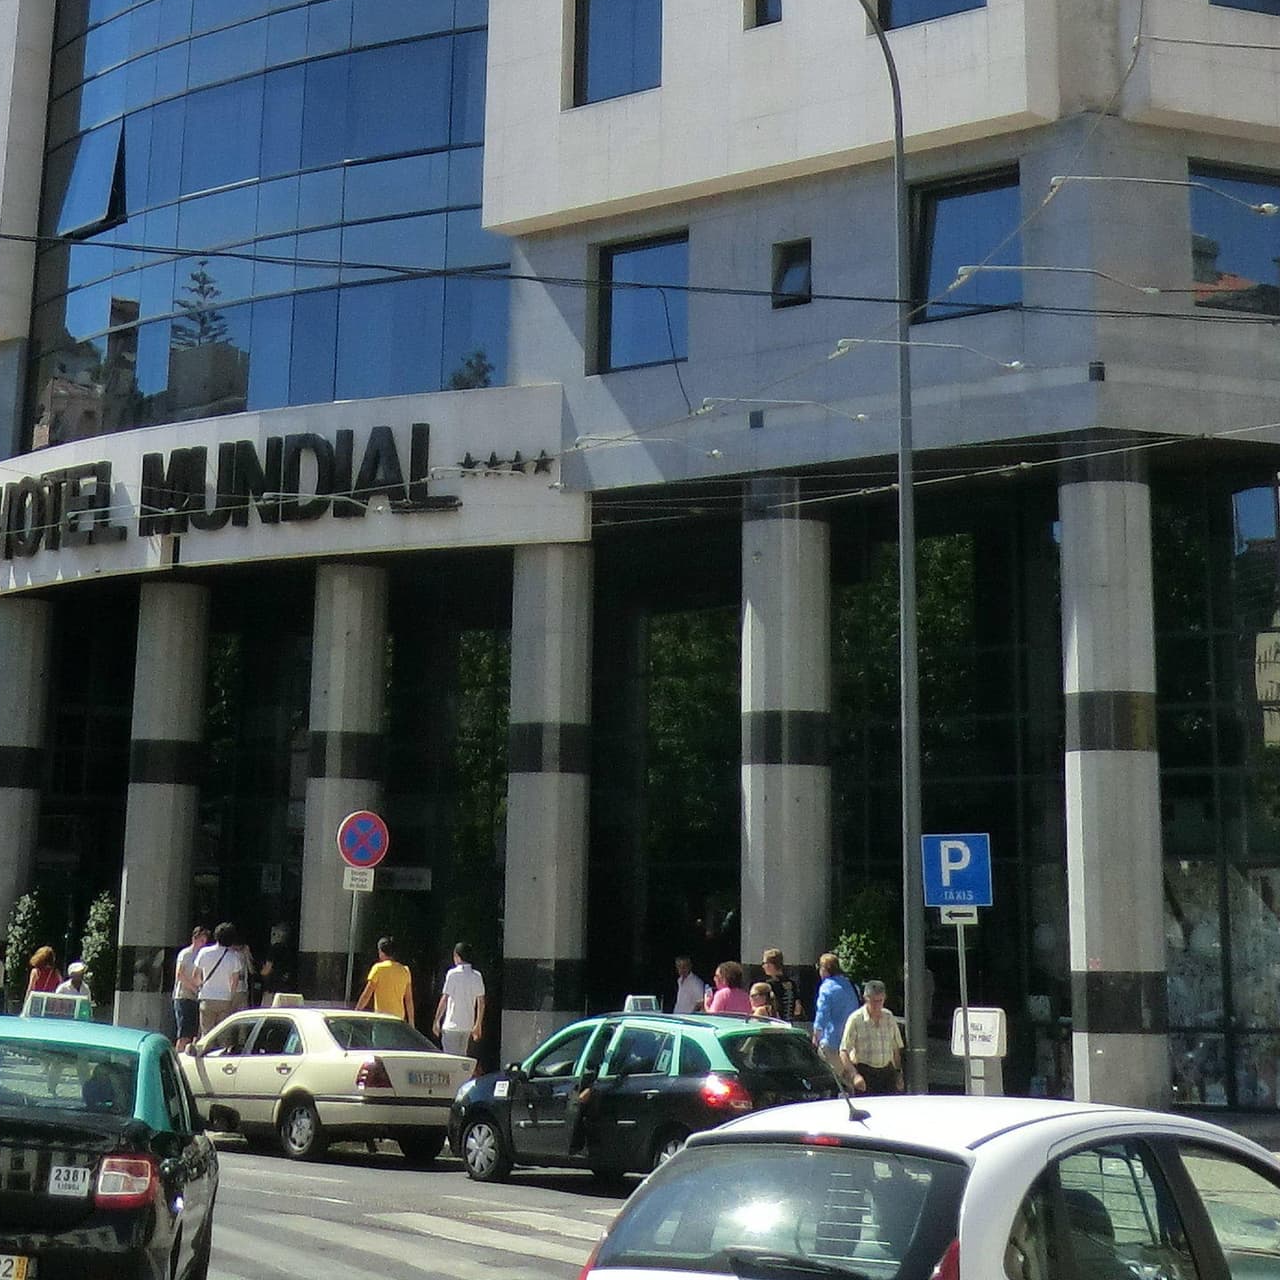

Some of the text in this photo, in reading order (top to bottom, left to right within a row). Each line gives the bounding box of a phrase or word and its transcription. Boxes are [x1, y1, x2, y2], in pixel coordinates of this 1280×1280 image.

[138, 423, 462, 537] MUNDIAL
[940, 840, 971, 887] P
[944, 890, 974, 901] TAXIS
[55, 1169, 86, 1183] 2381
